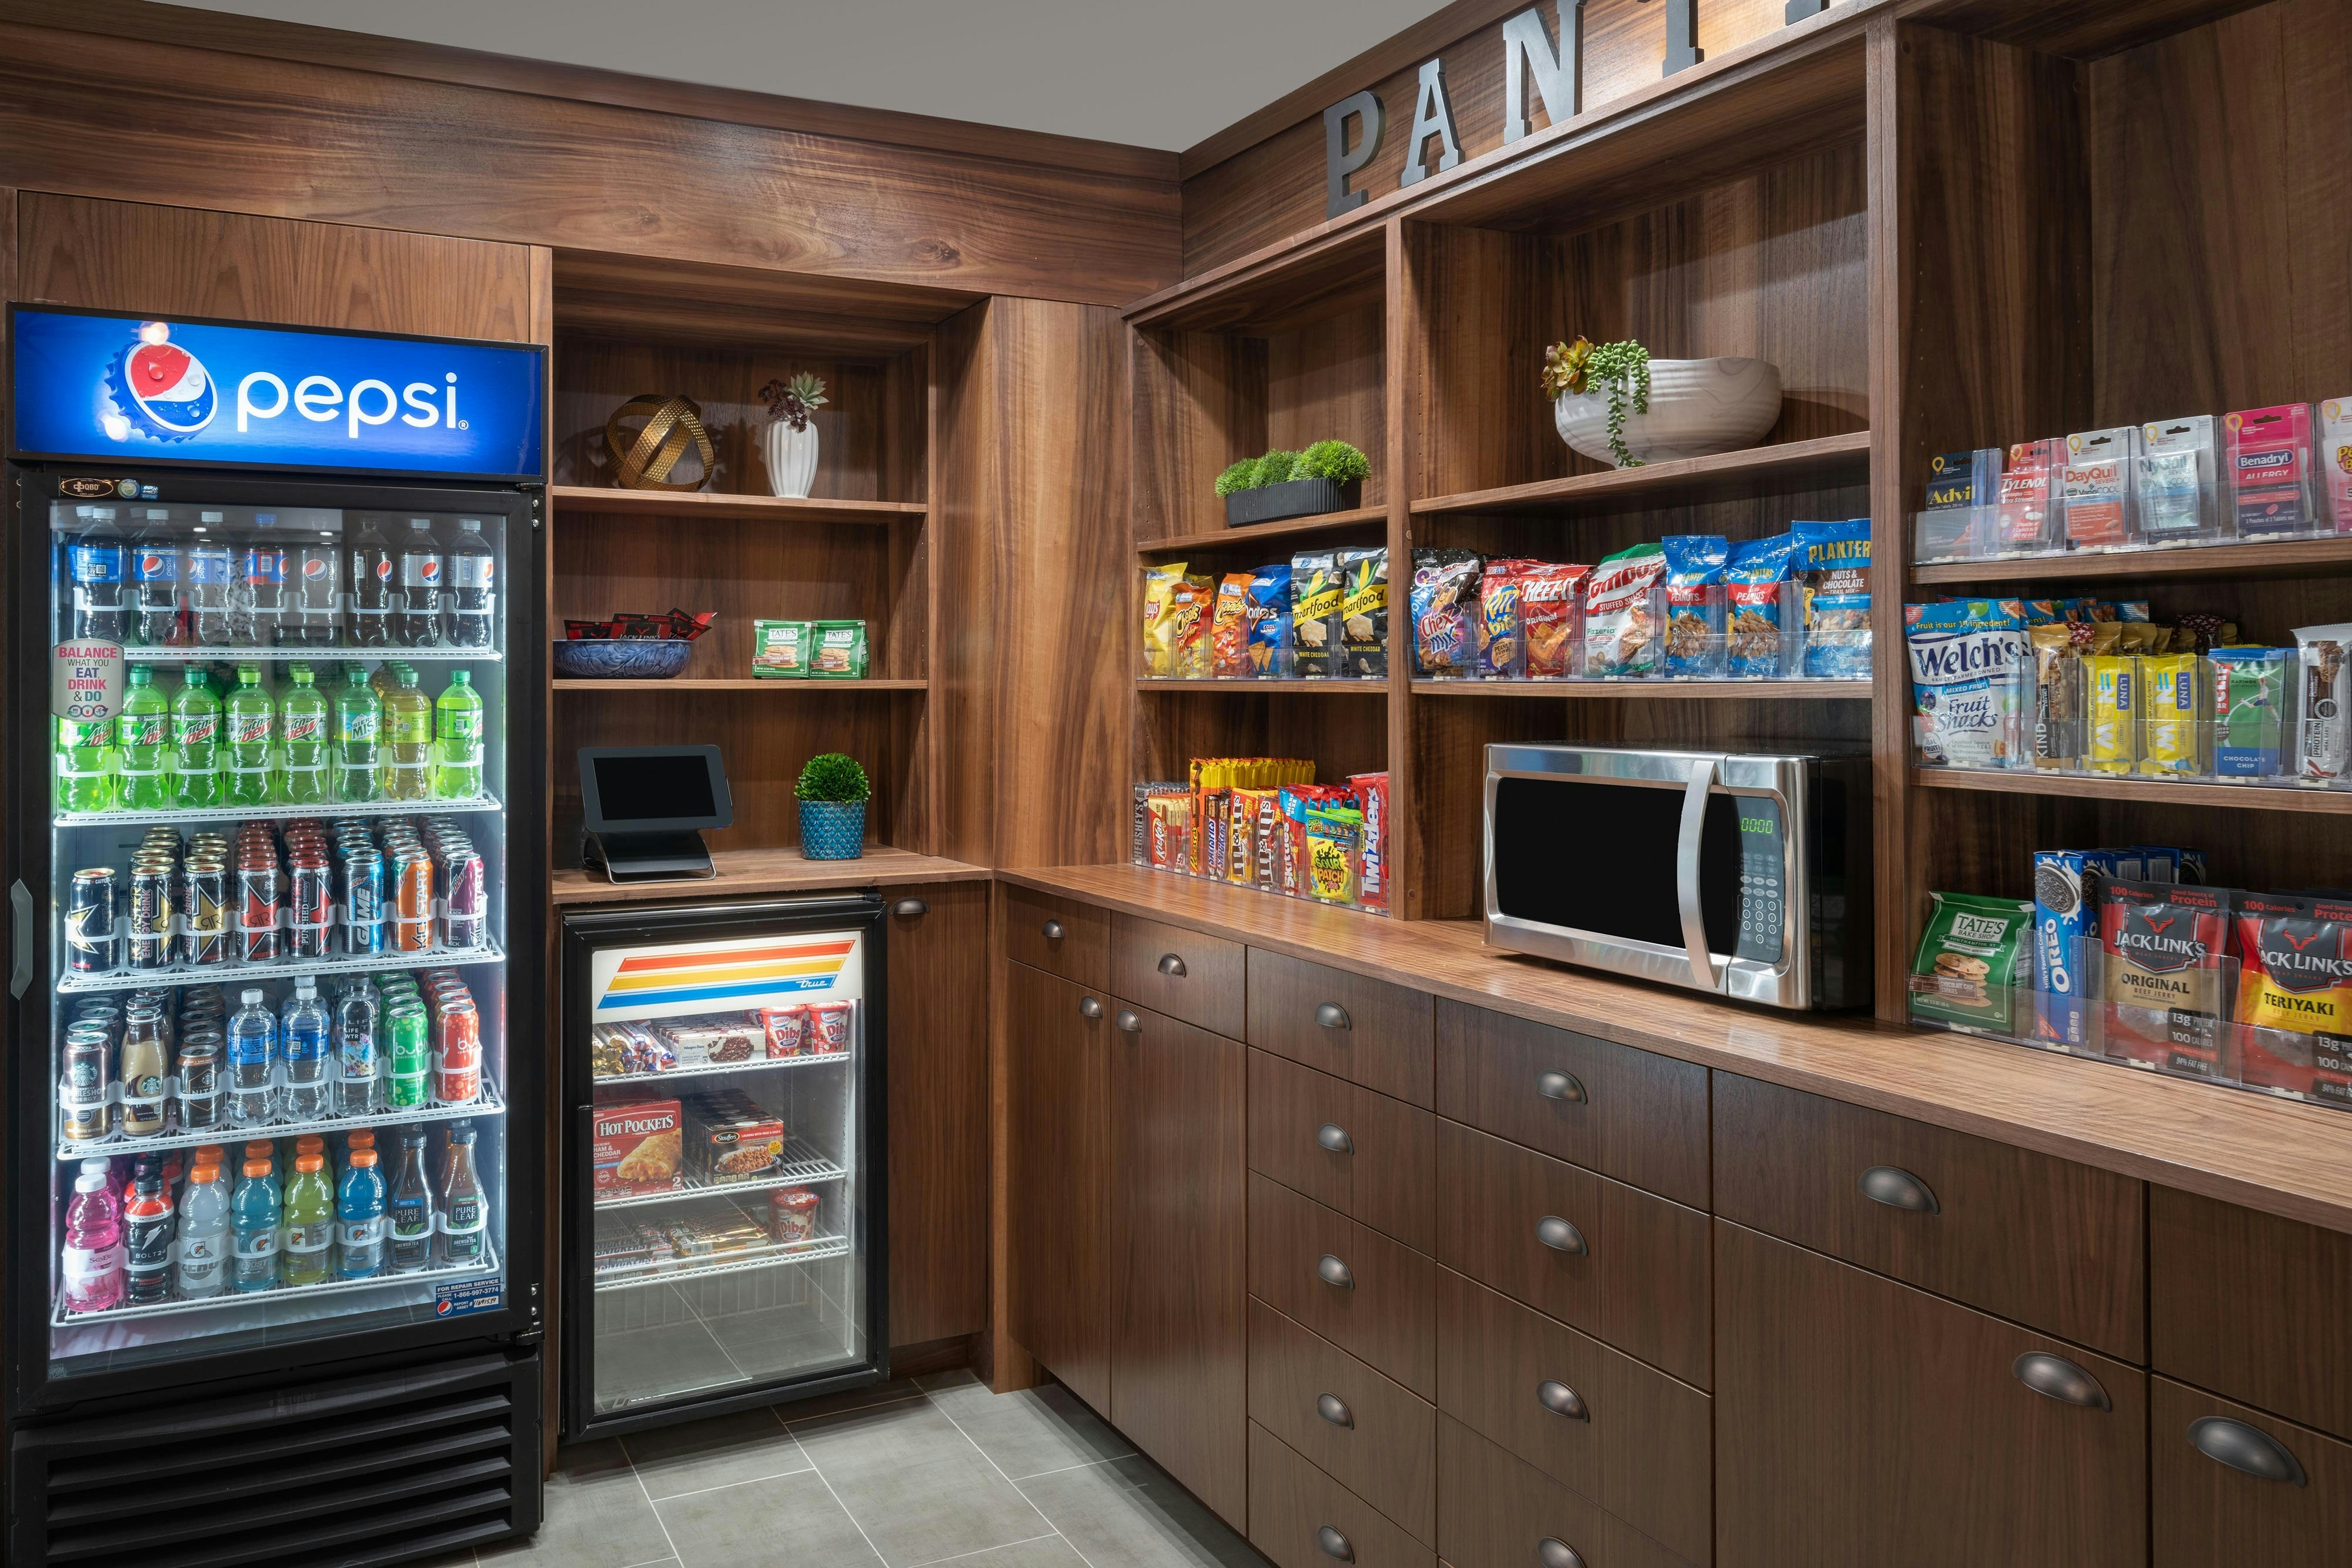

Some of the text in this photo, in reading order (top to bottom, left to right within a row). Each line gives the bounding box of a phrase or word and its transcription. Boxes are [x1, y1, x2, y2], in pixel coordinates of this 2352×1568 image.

[1324, 0, 1829, 220] PANT
[238, 372, 459, 438] pepsi
[2241, 453, 2288, 467] Benadryl
[2066, 466, 2117, 484] DayQuil
[2246, 470, 2289, 480] ALLERGY
[2001, 477, 2047, 491] TYLENOL
[1929, 486, 1976, 505] Advil
[1809, 540, 1871, 563] PLANTER
[1832, 570, 1857, 580] NUTS &
[1823, 579, 1864, 590] CHOCOLATE
[1343, 589, 1384, 616] martfood
[1672, 591, 1699, 601] PEANUTS
[1736, 591, 1765, 601] PEANUTS
[1294, 594, 1339, 620] martfood
[1484, 590, 1519, 620] RITZ
[1599, 600, 1623, 610] STUFFED
[1421, 608, 1455, 637] Chex
[1488, 615, 1516, 636] bits
[1970, 618, 2011, 628] Ingredient!
[1587, 627, 1615, 635] Pizzeria
[59, 647, 117, 658] BALANCE
[1912, 637, 2020, 677] Welch's
[76, 668, 100, 678] EAT,
[1954, 671, 1977, 680] FARMER
[1978, 667, 2000, 677] OWNED
[68, 680, 106, 690] DRINK
[1946, 682, 1986, 693] MIXED FRUIT
[2119, 677, 2127, 706] LUNA
[2178, 676, 2188, 706] LUNA
[74, 691, 102, 701] & DO
[1949, 696, 1991, 712] Fruit
[353, 717, 379, 739] MIST
[1937, 710, 1999, 733] Snacks
[2036, 723, 2047, 758] KIND
[1134, 804, 1144, 858] HERSHEY'S
[1315, 857, 1341, 870] SOUR
[1318, 870, 1344, 882] PATCH
[2110, 886, 2154, 898] 100 Calories
[142, 889, 151, 918] DRINK
[2171, 894, 2217, 907] Protein
[2244, 900, 2296, 913] 100 Calories
[2314, 909, 2352, 922] Prote
[1957, 914, 2006, 934] TATE'S
[1957, 930, 1977, 938] BAKE
[2114, 929, 2207, 957] JACK LINK'S
[2045, 918, 2070, 993] OREO
[2294, 955, 2352, 977] LINK'S
[1941, 981, 1963, 989] CHOCOLATE
[2120, 973, 2190, 995] ORIGINAL
[2134, 987, 2176, 999] BEEF JERKY
[2264, 992, 2335, 1016] TERIYAKI
[2173, 1013, 2191, 1027] 13g
[775, 1027, 801, 1041] Dibs
[2171, 1031, 2213, 1048] 100 CALORIES
[2318, 1036, 2340, 1051] 13g
[2188, 1059, 2199, 1069] FAT
[2318, 1056, 2338, 1069] 100
[600, 1115, 674, 1136] HOT POCKETS
[673, 1176, 681, 1187] 2
[395, 1208, 419, 1216] PURE
[456, 1206, 476, 1214] PURE
[396, 1215, 419, 1223] LEAF
[780, 1221, 806, 1234] Dibs
[136, 1250, 166, 1259] BOLT24
[454, 1287, 498, 1298] 1-866-997-3774
